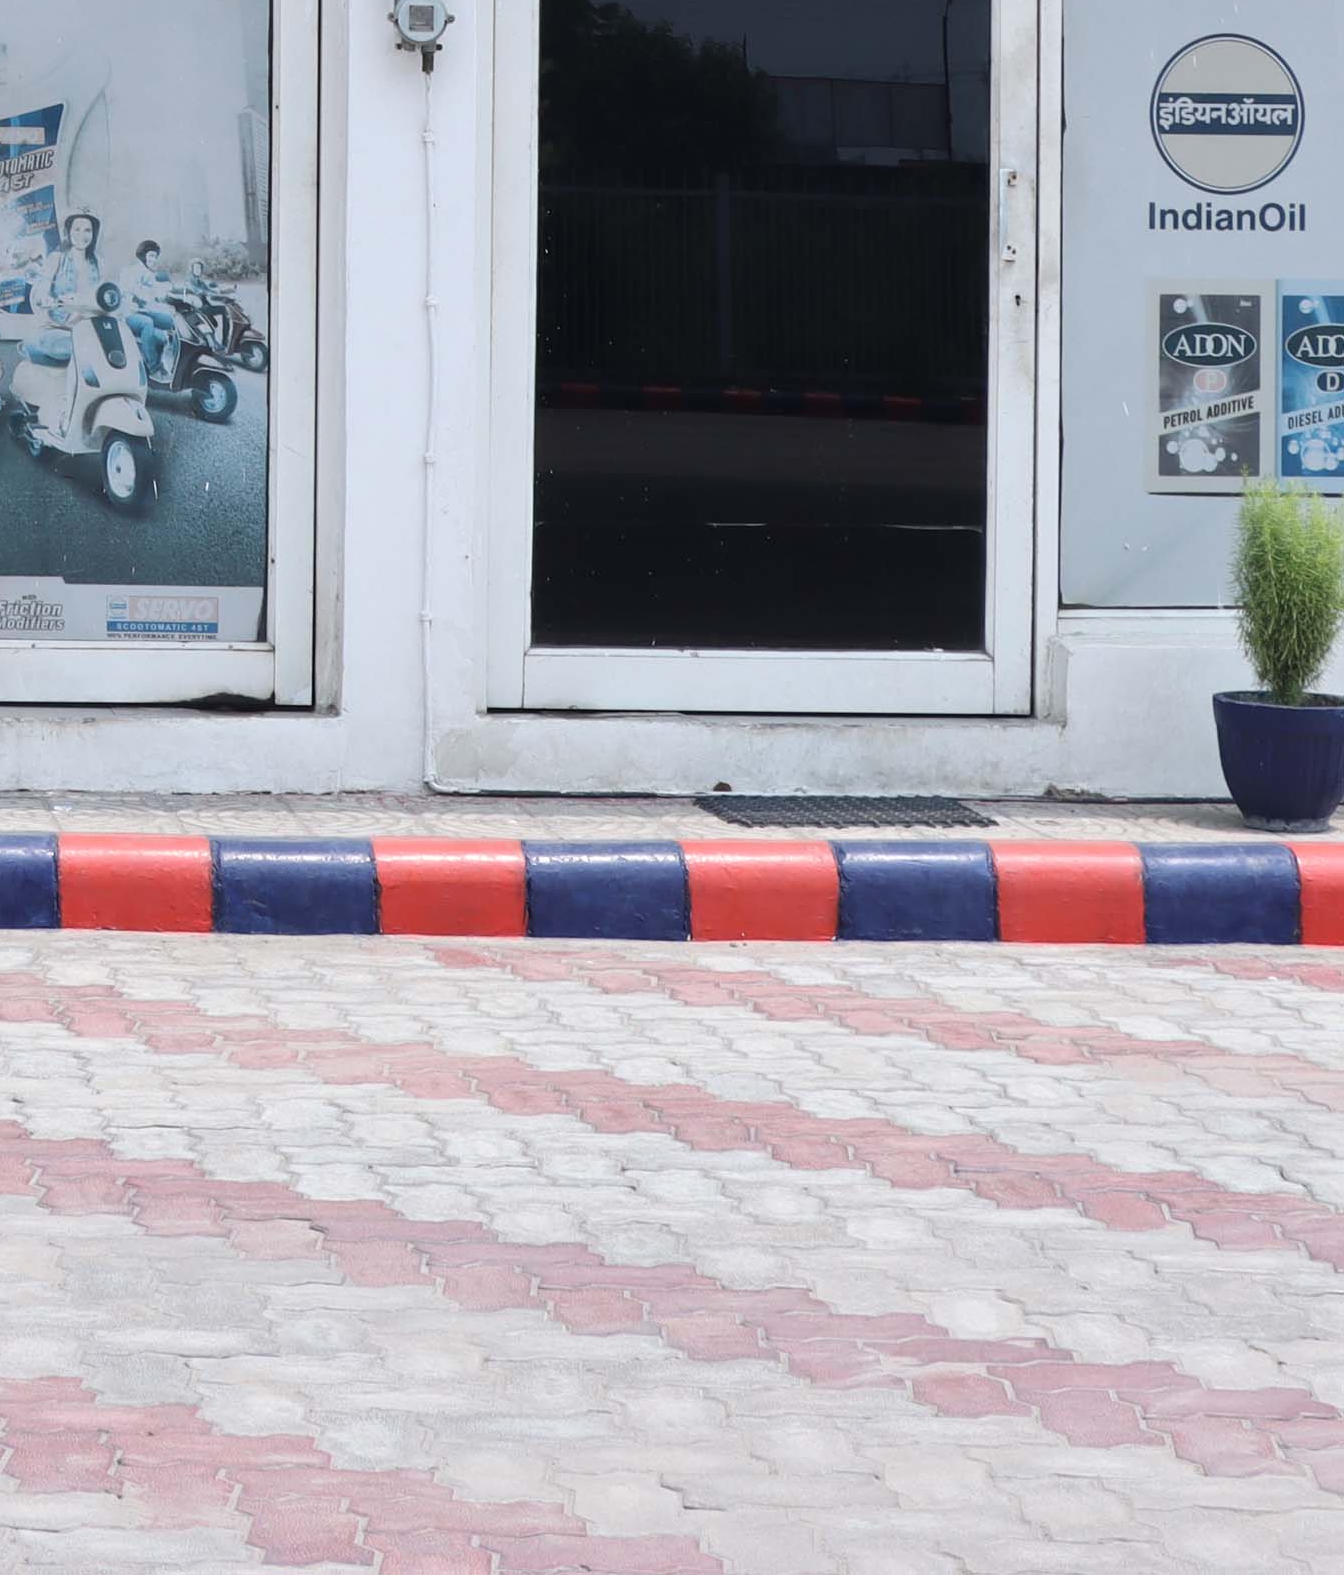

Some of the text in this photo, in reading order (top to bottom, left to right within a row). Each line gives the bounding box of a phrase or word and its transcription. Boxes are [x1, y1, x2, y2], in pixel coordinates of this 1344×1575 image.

[1158, 96, 1296, 130] इंडियनऑयल
[1148, 202, 1306, 232] IndianOil
[1173, 333, 1247, 357] ADON
[1163, 395, 1254, 429] PETROL ADDITIVE
[1288, 409, 1323, 430] DIESEL
[135, 598, 213, 620] SERVO
[116, 623, 188, 632] SCOOTOMATIC
